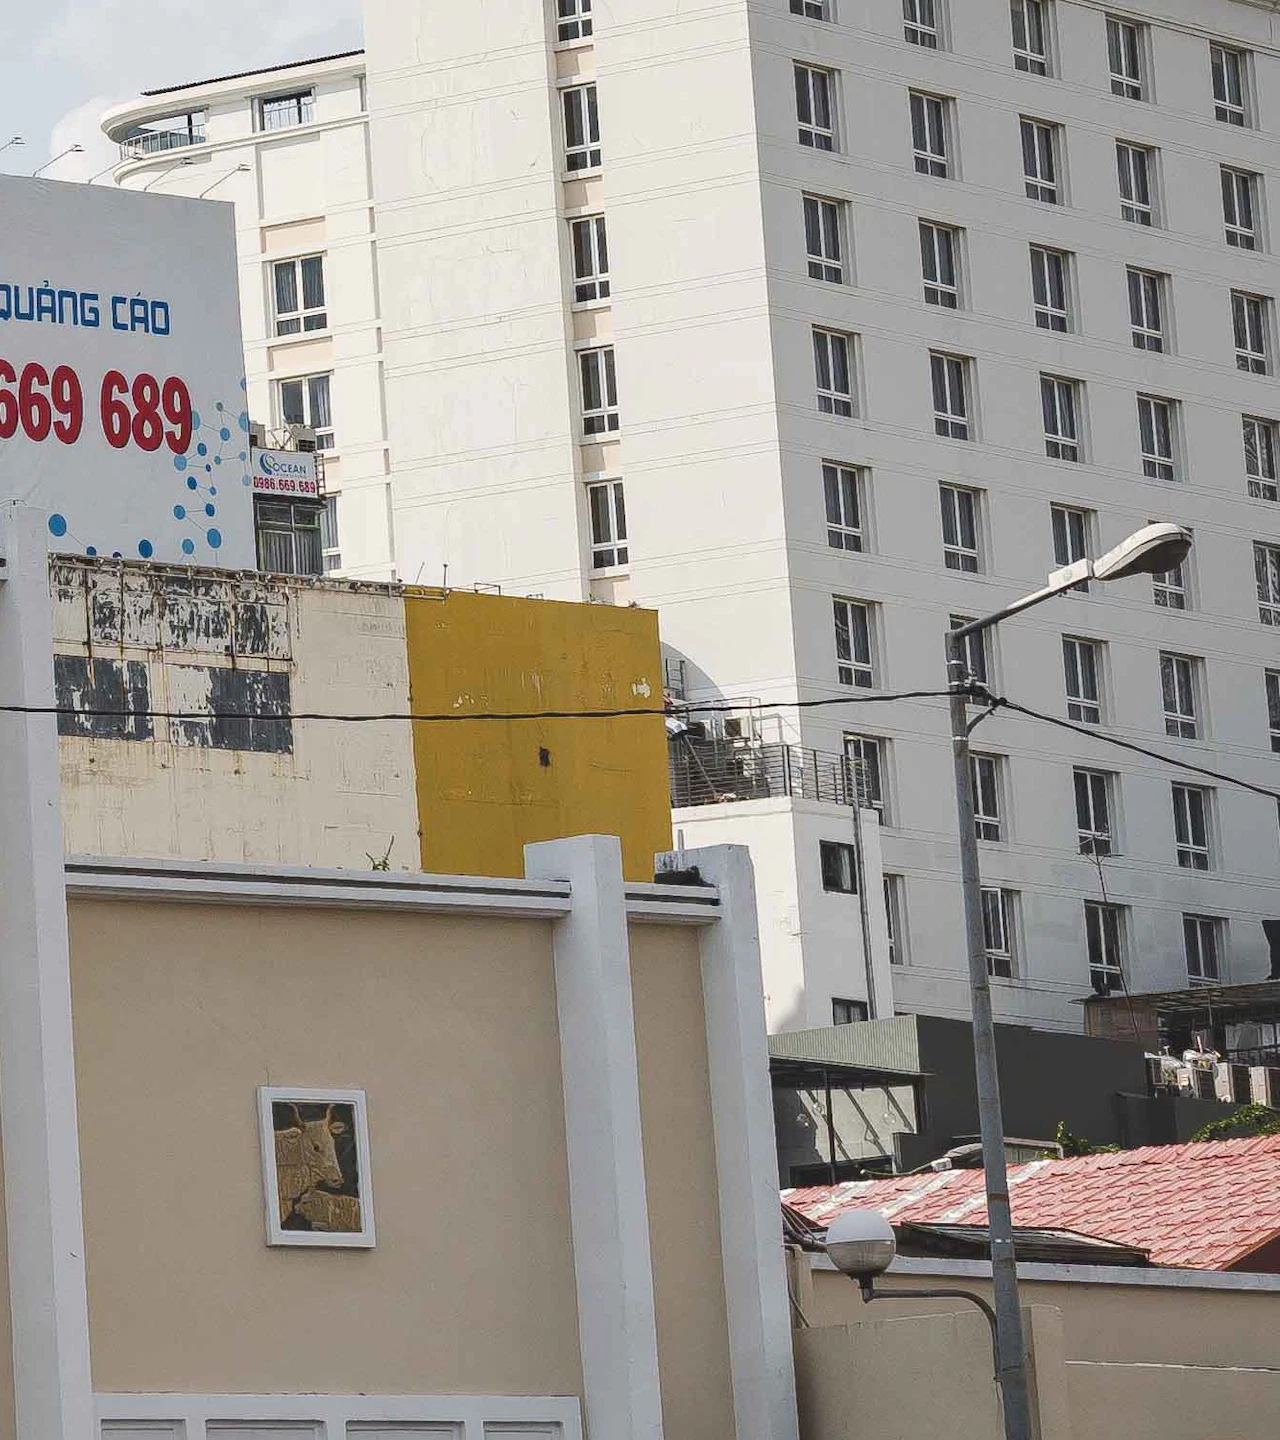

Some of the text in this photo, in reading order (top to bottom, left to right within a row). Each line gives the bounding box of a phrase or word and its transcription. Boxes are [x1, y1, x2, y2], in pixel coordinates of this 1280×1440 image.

[111, 291, 171, 336] CÁO
[100, 370, 193, 455] 689
[252, 475, 317, 494] 0986.669.689
[273, 462, 307, 475] OCEAN
